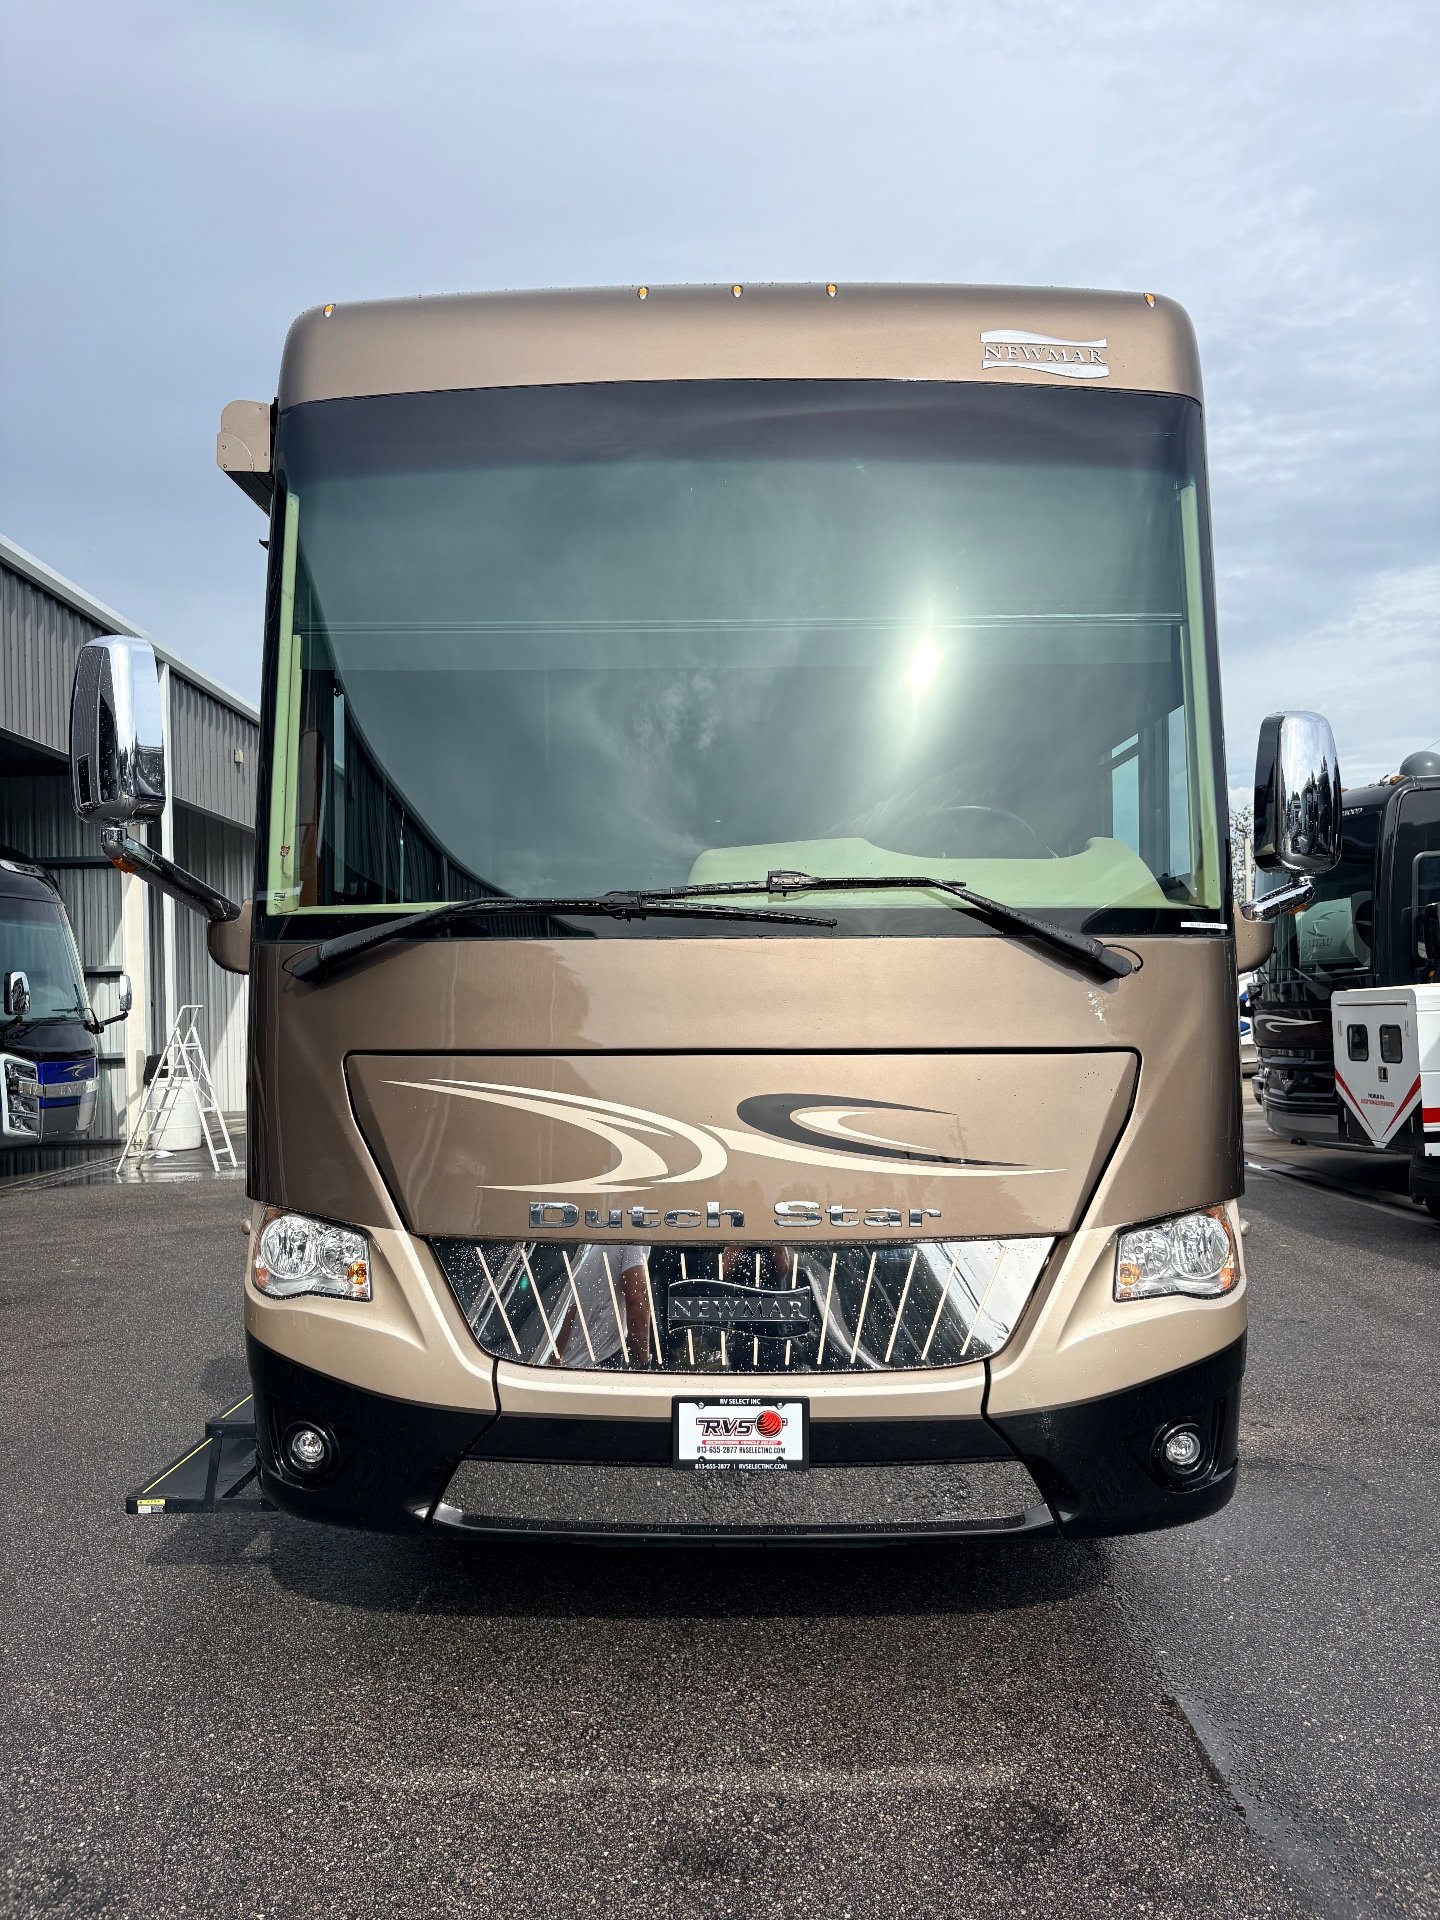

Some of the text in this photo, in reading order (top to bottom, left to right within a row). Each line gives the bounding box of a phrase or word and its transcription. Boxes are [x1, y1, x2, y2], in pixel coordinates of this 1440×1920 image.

[984, 345, 1106, 364] NEWMAR
[528, 1200, 942, 1228] Dutch Star
[671, 1299, 806, 1320] NEWMAR
[696, 1418, 755, 1436] RVS
[697, 1446, 738, 1454] 813-655-2877
